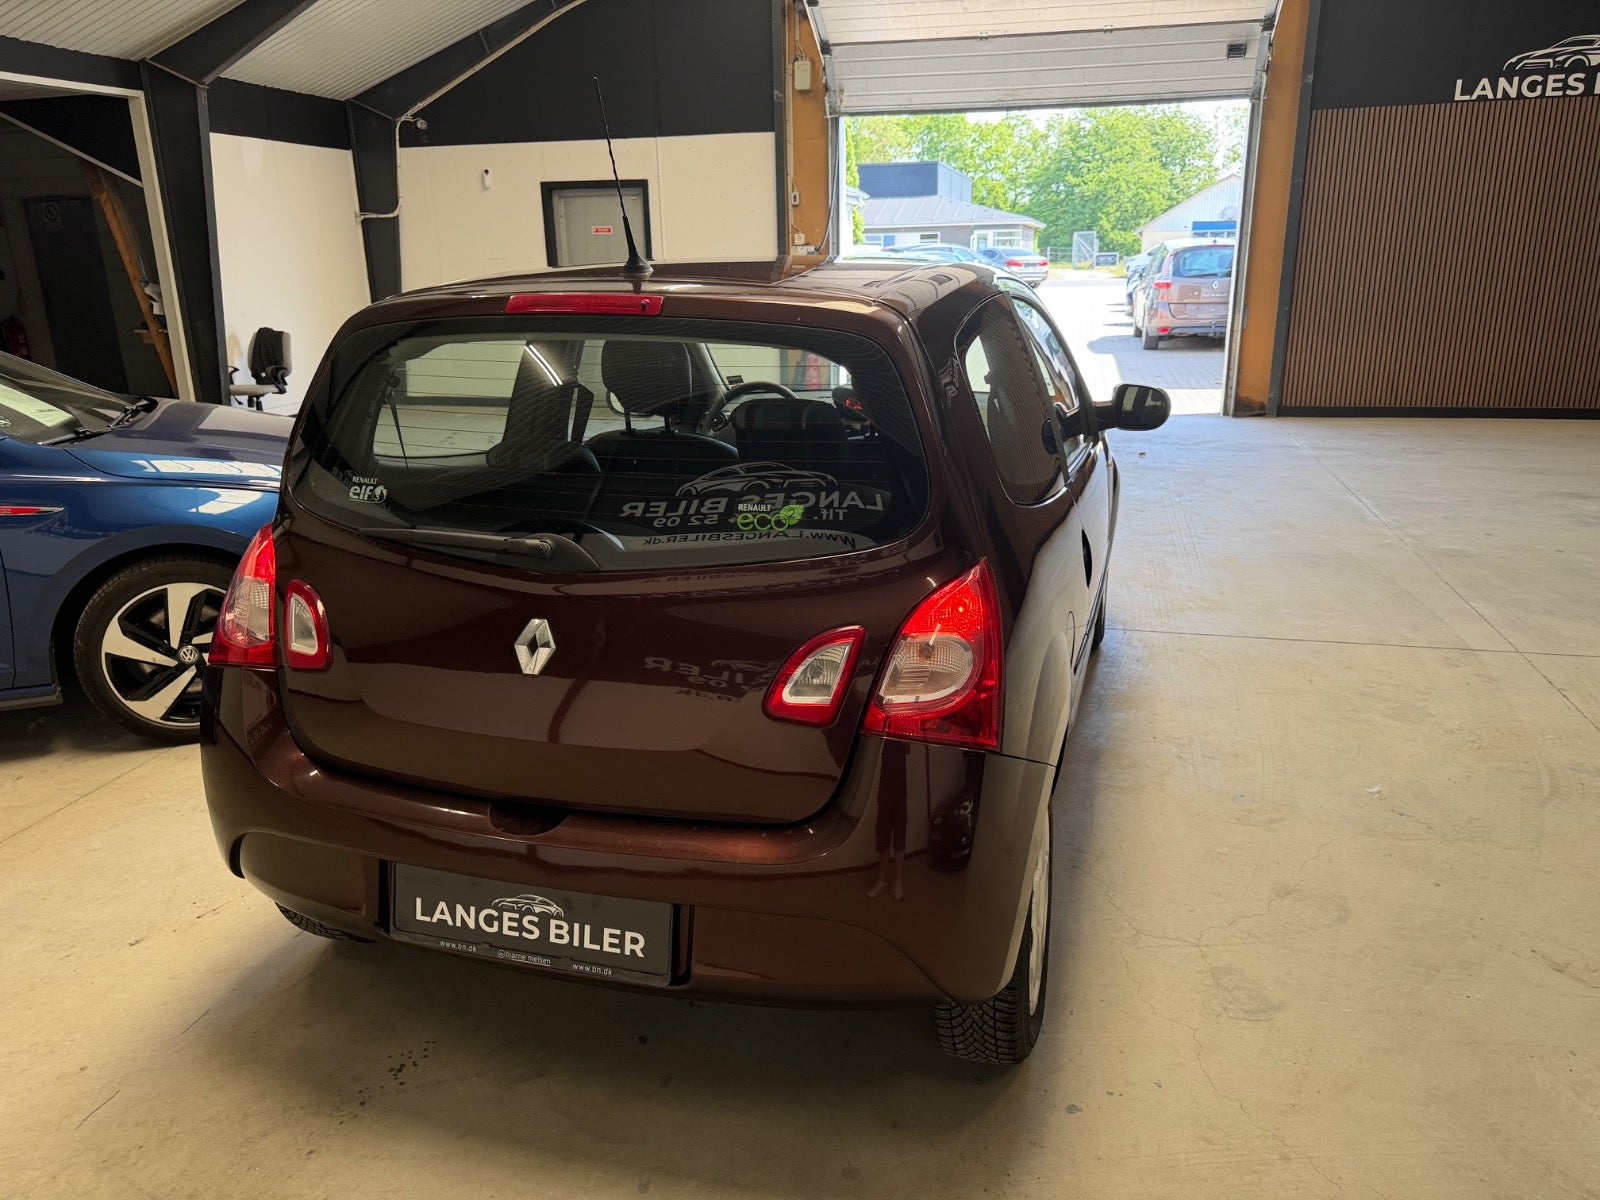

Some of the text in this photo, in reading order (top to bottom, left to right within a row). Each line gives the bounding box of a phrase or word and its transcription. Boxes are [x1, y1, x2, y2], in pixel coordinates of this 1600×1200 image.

[1454, 73, 1586, 101] LANGES
[352, 476, 378, 484] RENAULT
[349, 485, 374, 500] elf
[738, 503, 772, 512] RENAULT
[415, 897, 646, 958] LANGES BILER
[439, 940, 478, 953] www.bn.dk
[572, 963, 613, 976] www.bn.dk
